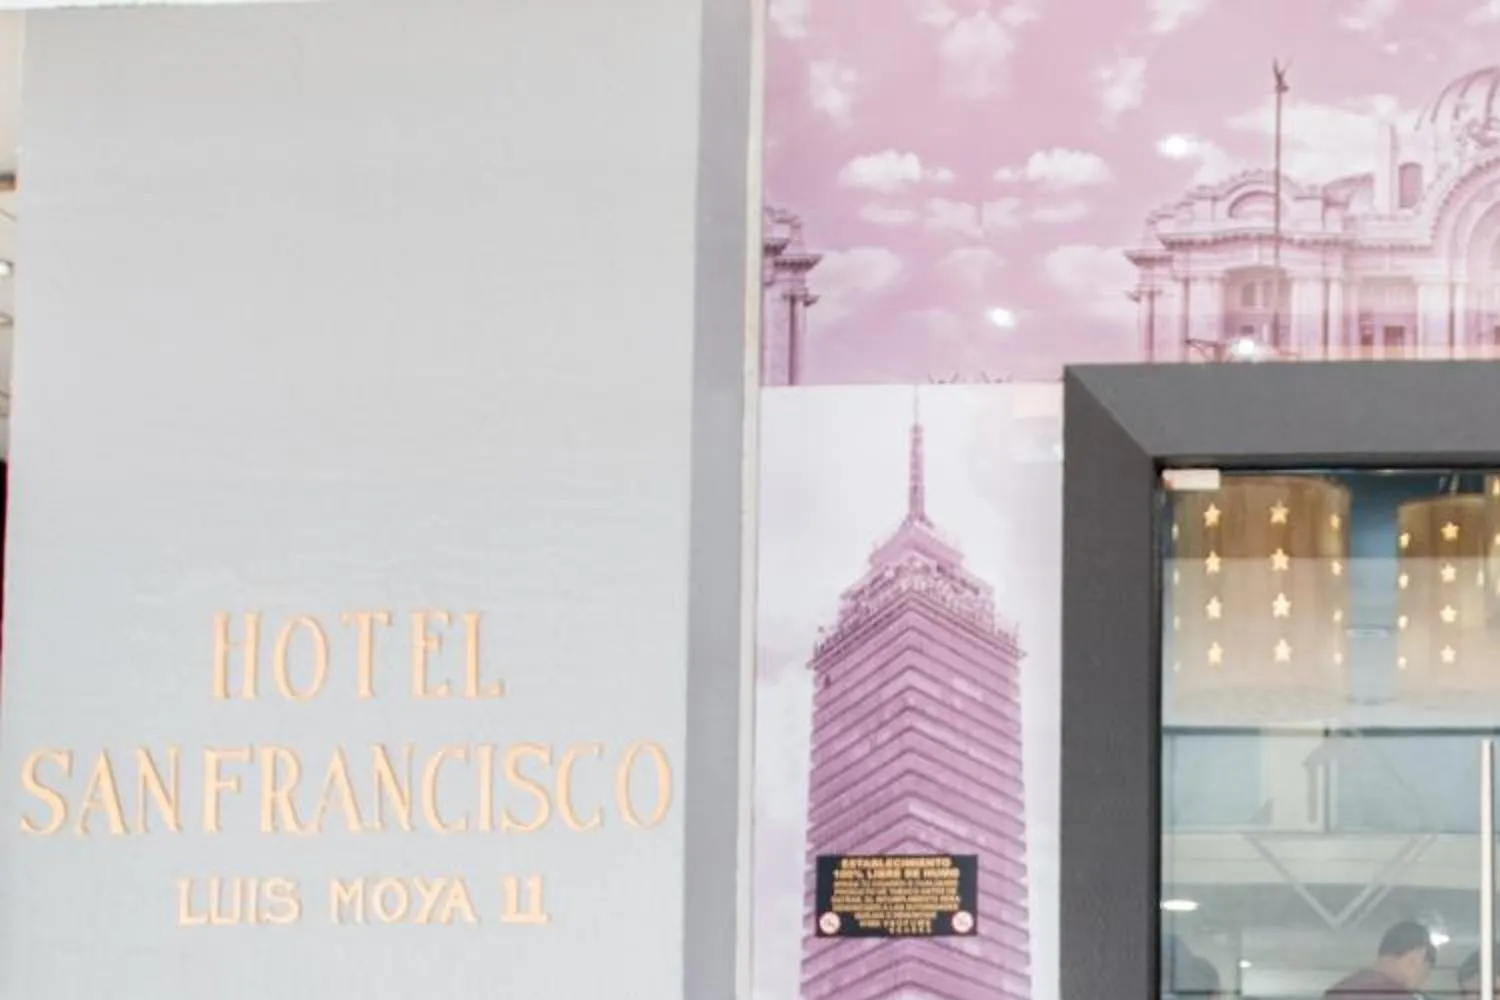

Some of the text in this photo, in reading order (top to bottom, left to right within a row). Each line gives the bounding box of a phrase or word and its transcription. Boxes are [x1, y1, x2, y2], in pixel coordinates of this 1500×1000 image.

[212, 608, 506, 700] HOTEL
[19, 740, 675, 837] SAN FRANCISCO
[176, 871, 551, 927] LUIS MOYA 11
